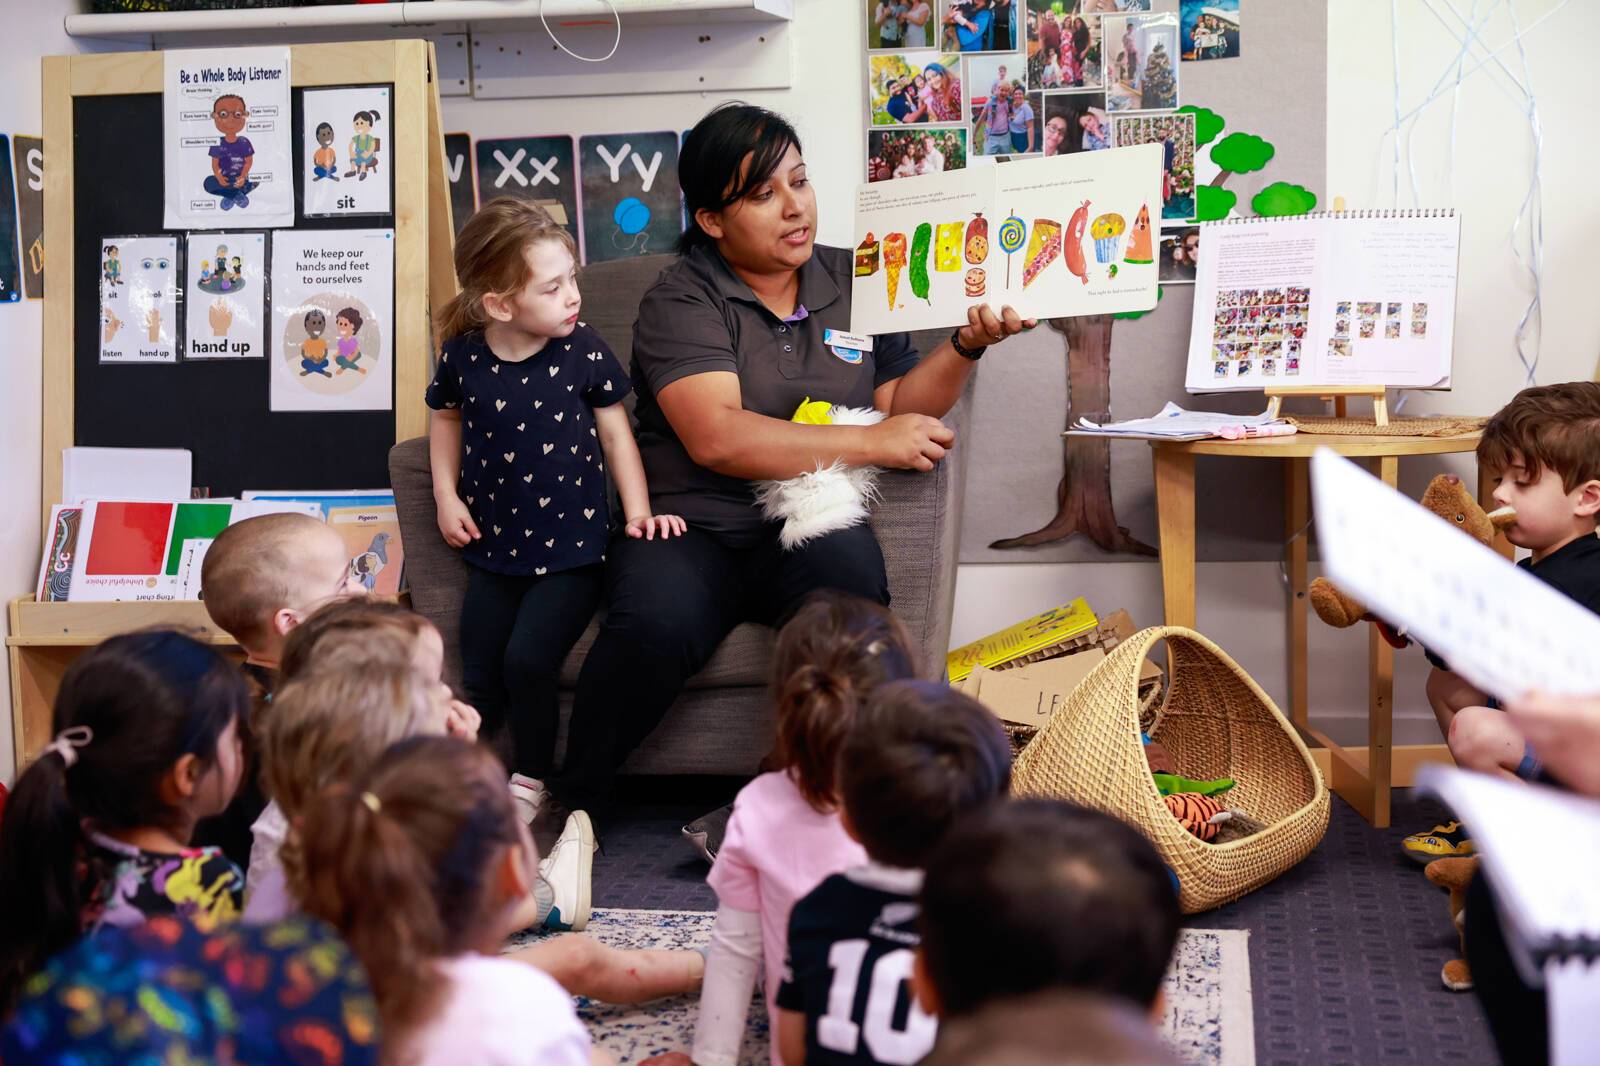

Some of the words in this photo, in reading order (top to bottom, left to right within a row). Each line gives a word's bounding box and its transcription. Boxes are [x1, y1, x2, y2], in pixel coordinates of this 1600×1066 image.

[180, 70, 190, 83] Be
[193, 73, 198, 83] a
[201, 68, 225, 83] Whole
[227, 67, 247, 85] Body
[249, 67, 281, 80] Listener
[27, 148, 43, 191] S
[493, 148, 560, 189] Xx
[596, 142, 663, 193] Yy
[336, 195, 356, 209] sit
[303, 249, 319, 259] We
[321, 249, 344, 260] keep
[346, 250, 364, 258] our
[296, 261, 326, 271] hands
[328, 260, 347, 271] and
[349, 260, 370, 270] feet
[302, 275, 313, 284] to
[315, 274, 362, 284] ourselves
[108, 290, 117, 299] sit
[102, 349, 122, 357] listen
[192, 339, 228, 353] hand
[231, 343, 250, 356] up
[139, 349, 158, 357] hand
[159, 350, 169, 359] up
[86, 578, 108, 586] choice
[109, 578, 144, 588] Unhelpful
[136, 593, 155, 601] chart
[156, 593, 175, 601] rting
[817, 938, 939, 1066] 10
